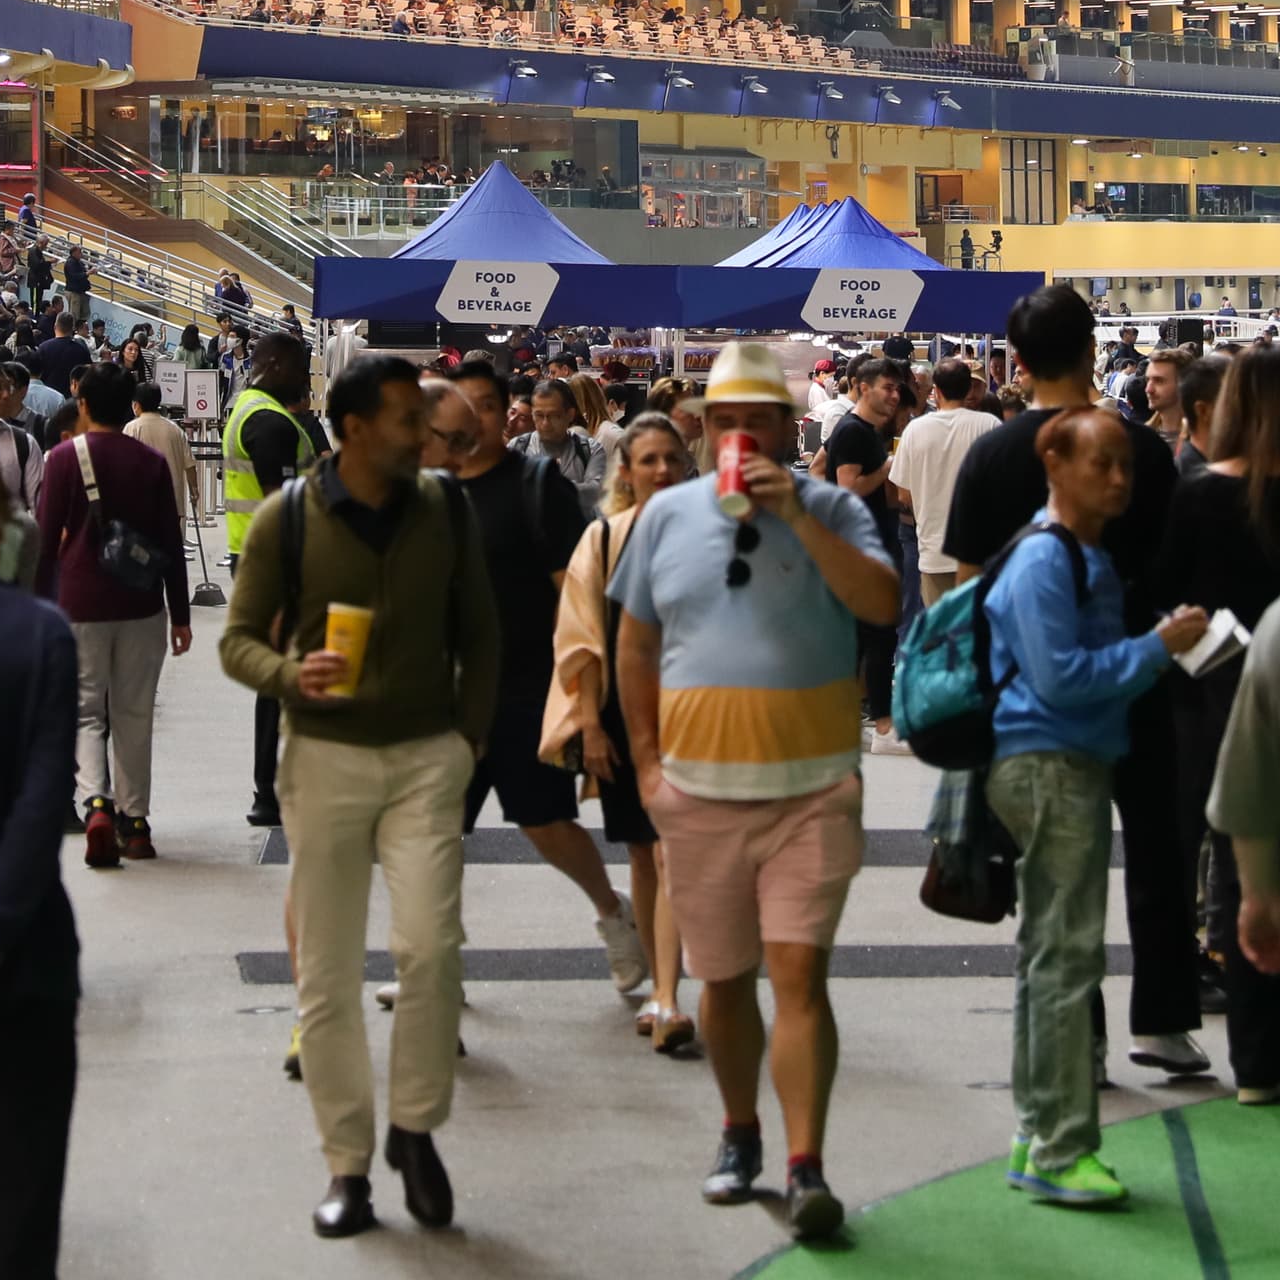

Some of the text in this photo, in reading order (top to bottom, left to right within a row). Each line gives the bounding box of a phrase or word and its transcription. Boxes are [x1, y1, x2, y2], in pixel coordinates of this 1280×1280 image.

[475, 272, 516, 284] FOOD
[840, 280, 881, 291] FOOD
[490, 286, 500, 298] &
[855, 294, 865, 305] &
[457, 299, 532, 313] BEVERAGE
[823, 307, 897, 319] BEVERAGE
